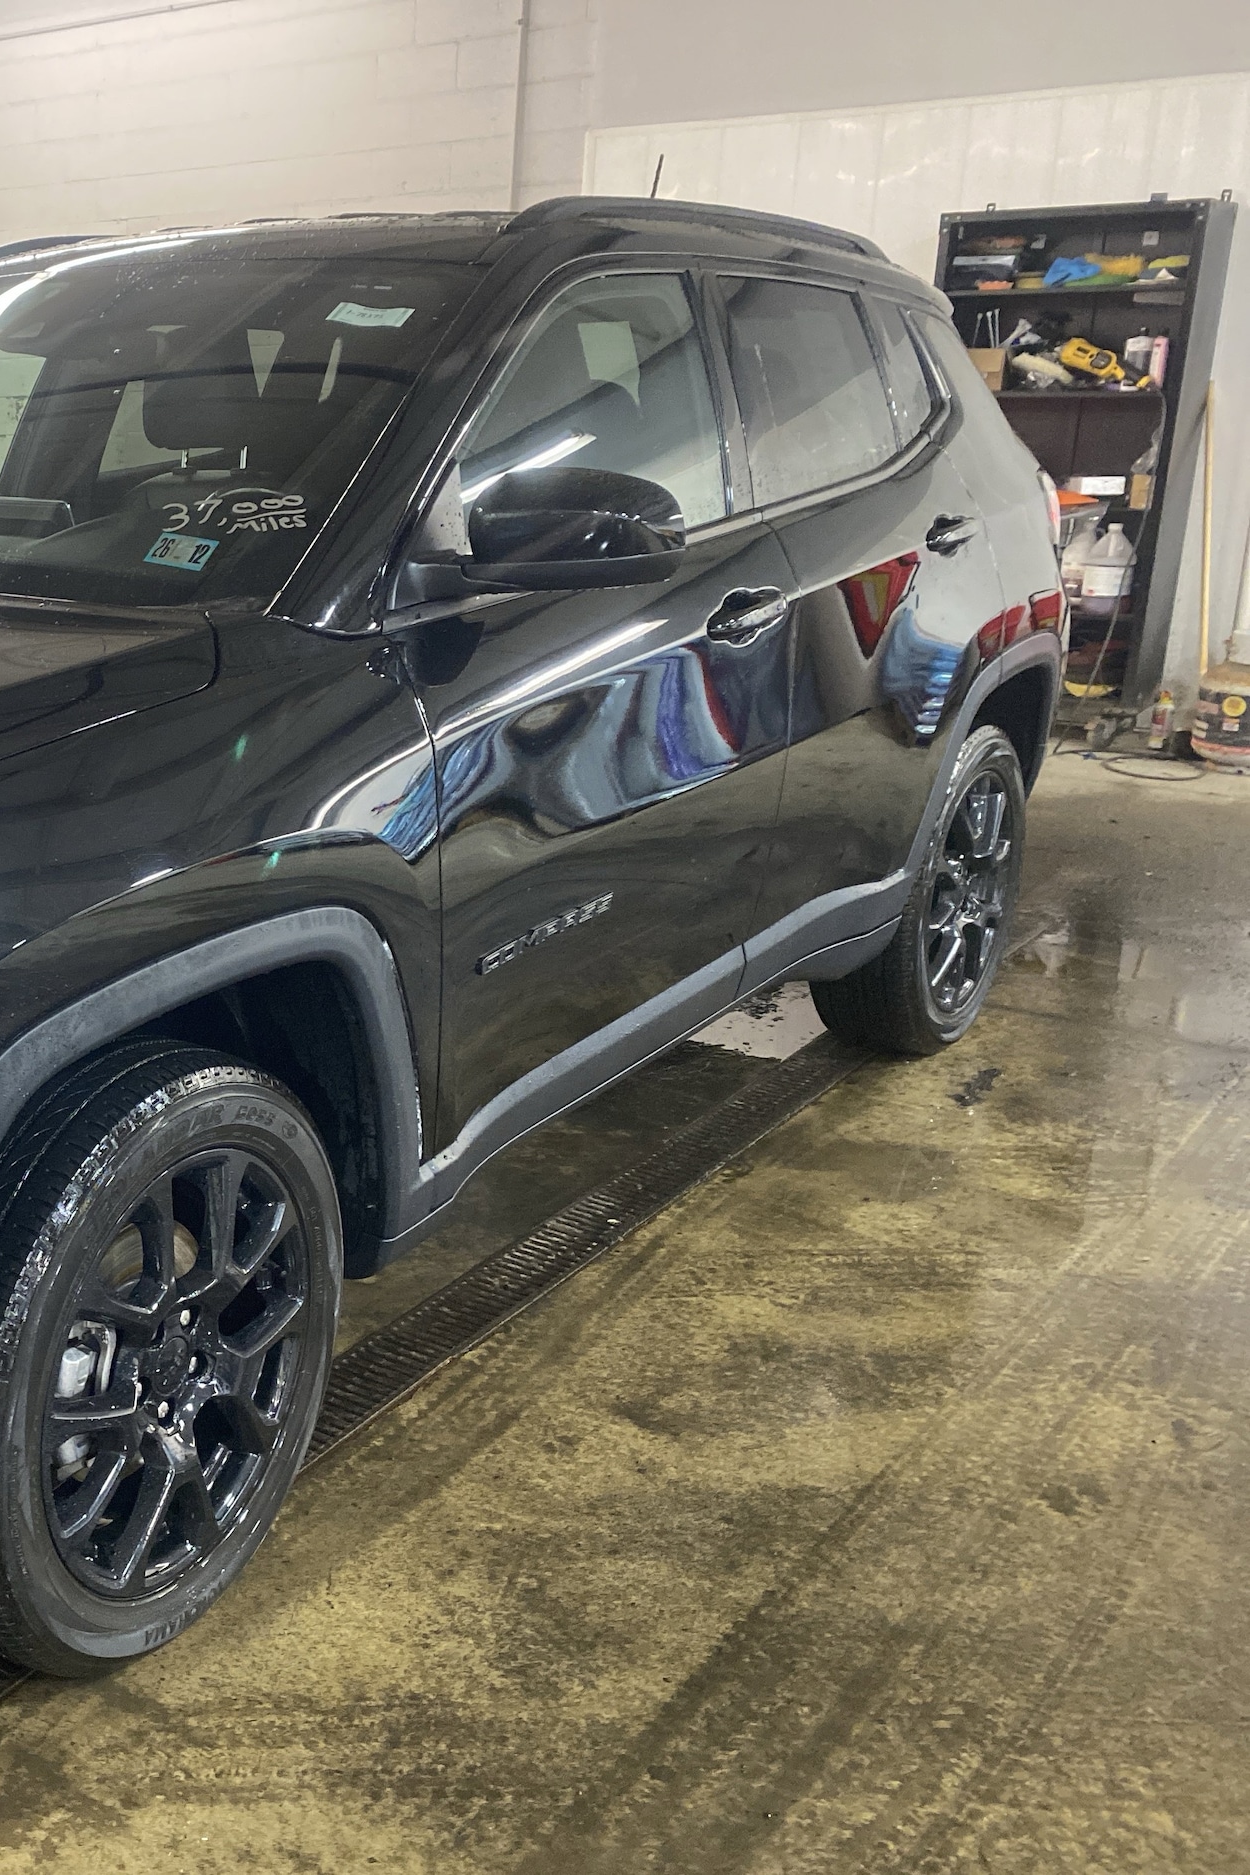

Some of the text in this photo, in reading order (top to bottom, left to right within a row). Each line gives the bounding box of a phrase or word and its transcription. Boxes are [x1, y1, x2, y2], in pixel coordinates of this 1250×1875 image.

[161, 495, 305, 533] 37,000
[151, 537, 211, 564] 26 12
[475, 891, 614, 975] COMPASS
